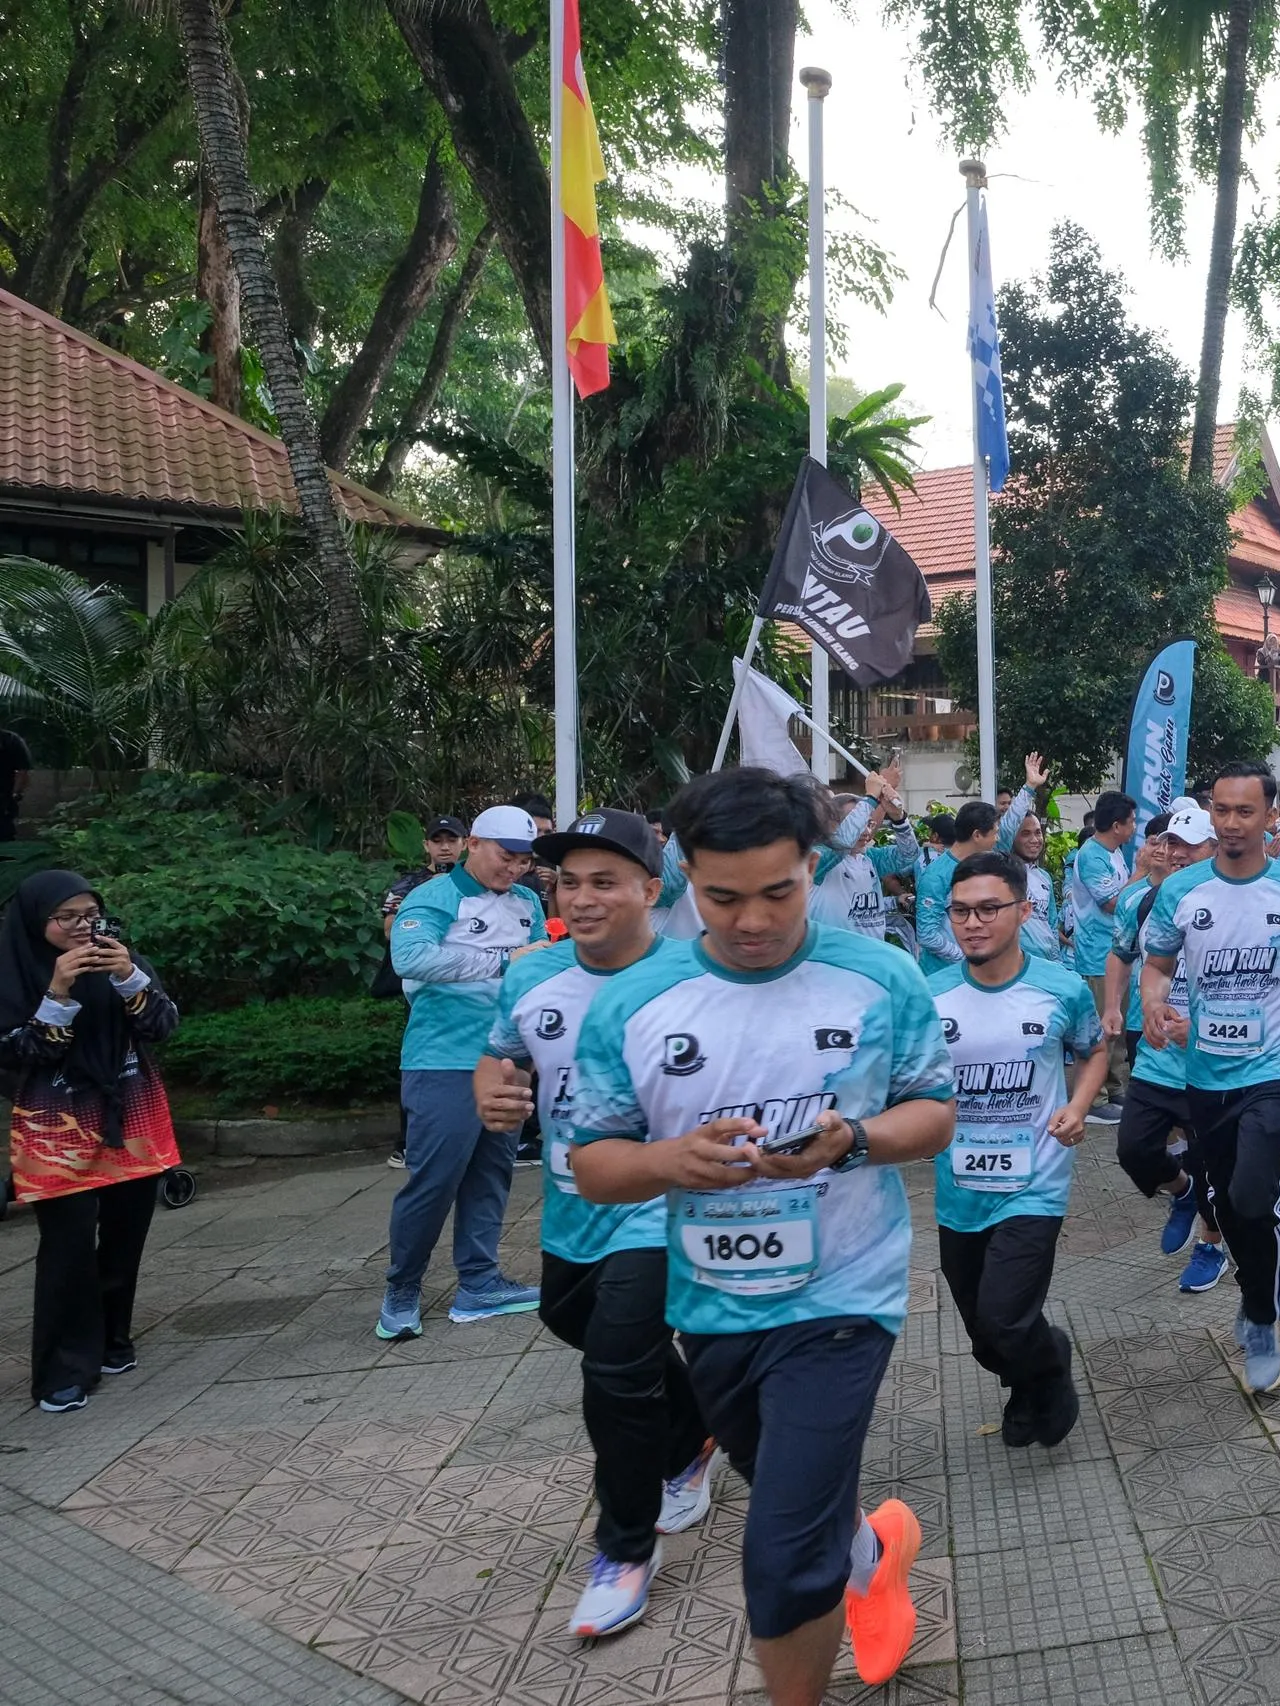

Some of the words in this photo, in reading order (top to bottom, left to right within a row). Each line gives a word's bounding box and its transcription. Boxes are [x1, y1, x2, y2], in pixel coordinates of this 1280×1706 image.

[831, 642, 860, 671] KLANG
[1142, 718, 1165, 810] RUN
[1203, 949, 1239, 977] FUN
[1237, 947, 1277, 975] RUN
[1208, 1022, 1248, 1039] 2424
[954, 1064, 993, 1095] FUN
[990, 1060, 1035, 1095] RUN
[965, 1154, 1012, 1171] 2475
[704, 1231, 784, 1261] 1806
